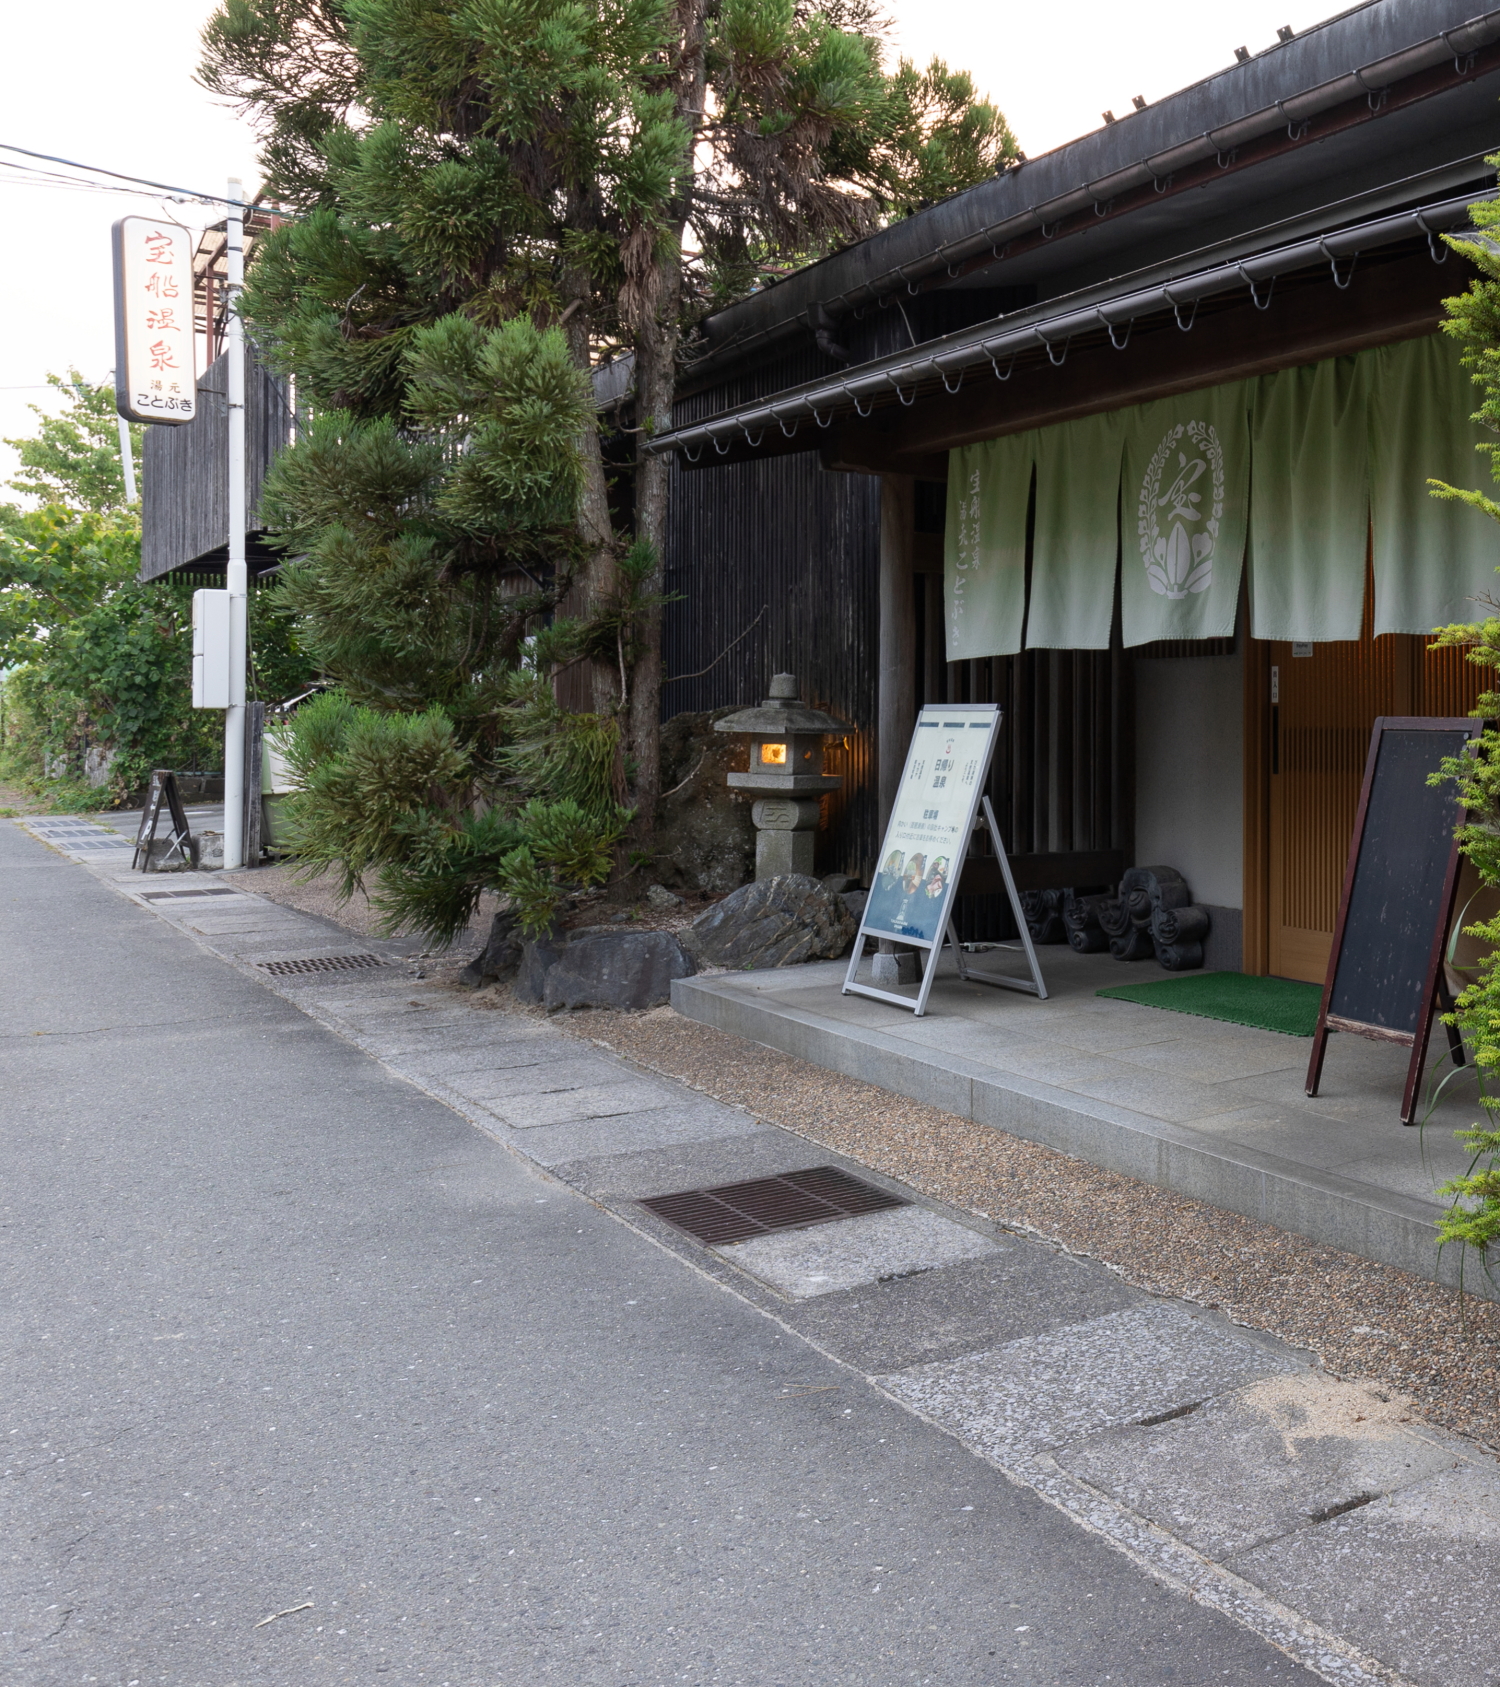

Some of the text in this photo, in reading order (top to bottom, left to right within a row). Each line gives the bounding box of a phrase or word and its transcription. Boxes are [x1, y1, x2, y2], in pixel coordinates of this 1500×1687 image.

[144, 231, 181, 371] 宝船温泉
[151, 379, 181, 394] 湯元
[137, 393, 193, 412] ことぶき
